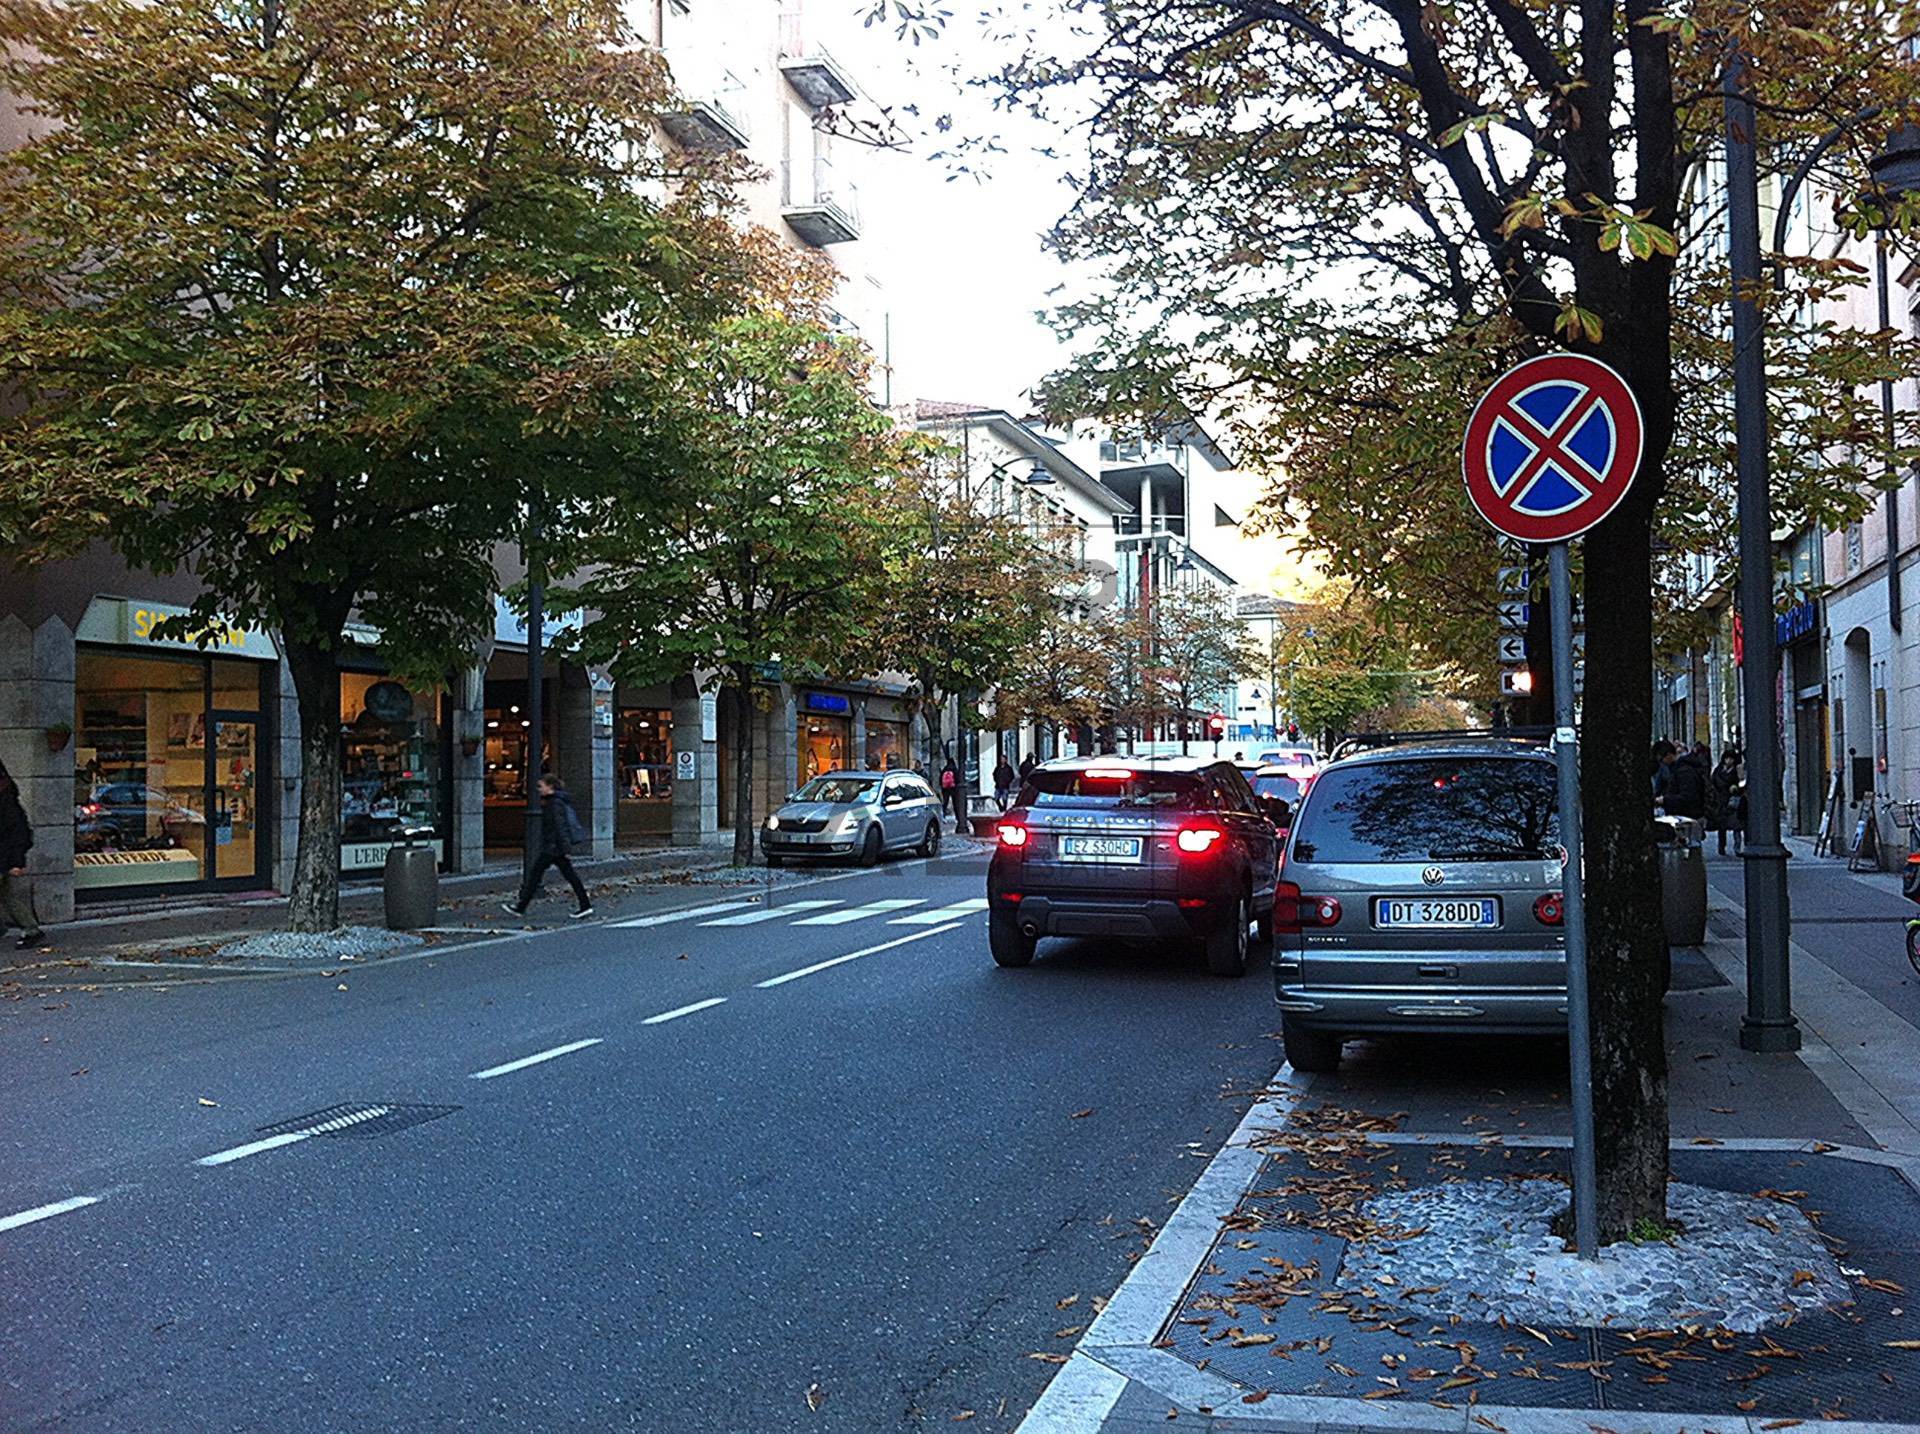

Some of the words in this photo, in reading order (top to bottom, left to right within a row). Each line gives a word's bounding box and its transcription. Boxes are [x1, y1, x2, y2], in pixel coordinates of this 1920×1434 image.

[1074, 840, 1089, 854] EZ
[75, 851, 171, 866] VALLEVERDE
[1392, 903, 1414, 921] DT
[1421, 903, 1480, 921] 328DD
